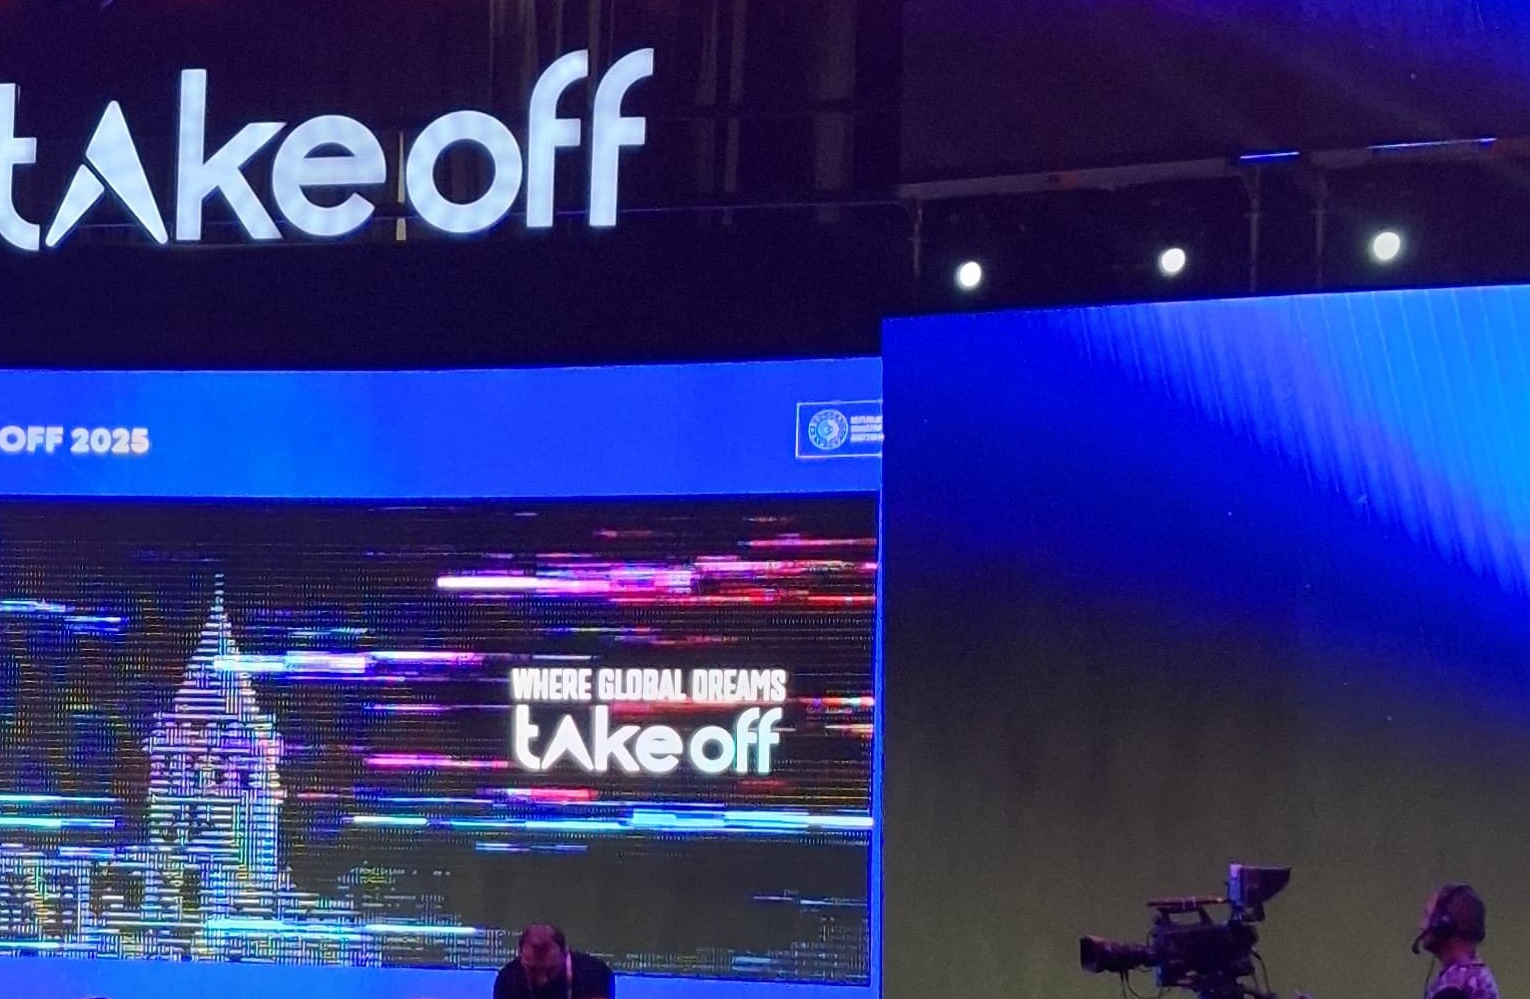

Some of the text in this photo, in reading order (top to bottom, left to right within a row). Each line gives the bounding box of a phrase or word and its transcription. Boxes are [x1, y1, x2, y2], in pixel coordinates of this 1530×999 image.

[70, 427, 150, 453] 2025
[511, 668, 788, 701] WHERE GLOBAL DREAMS
